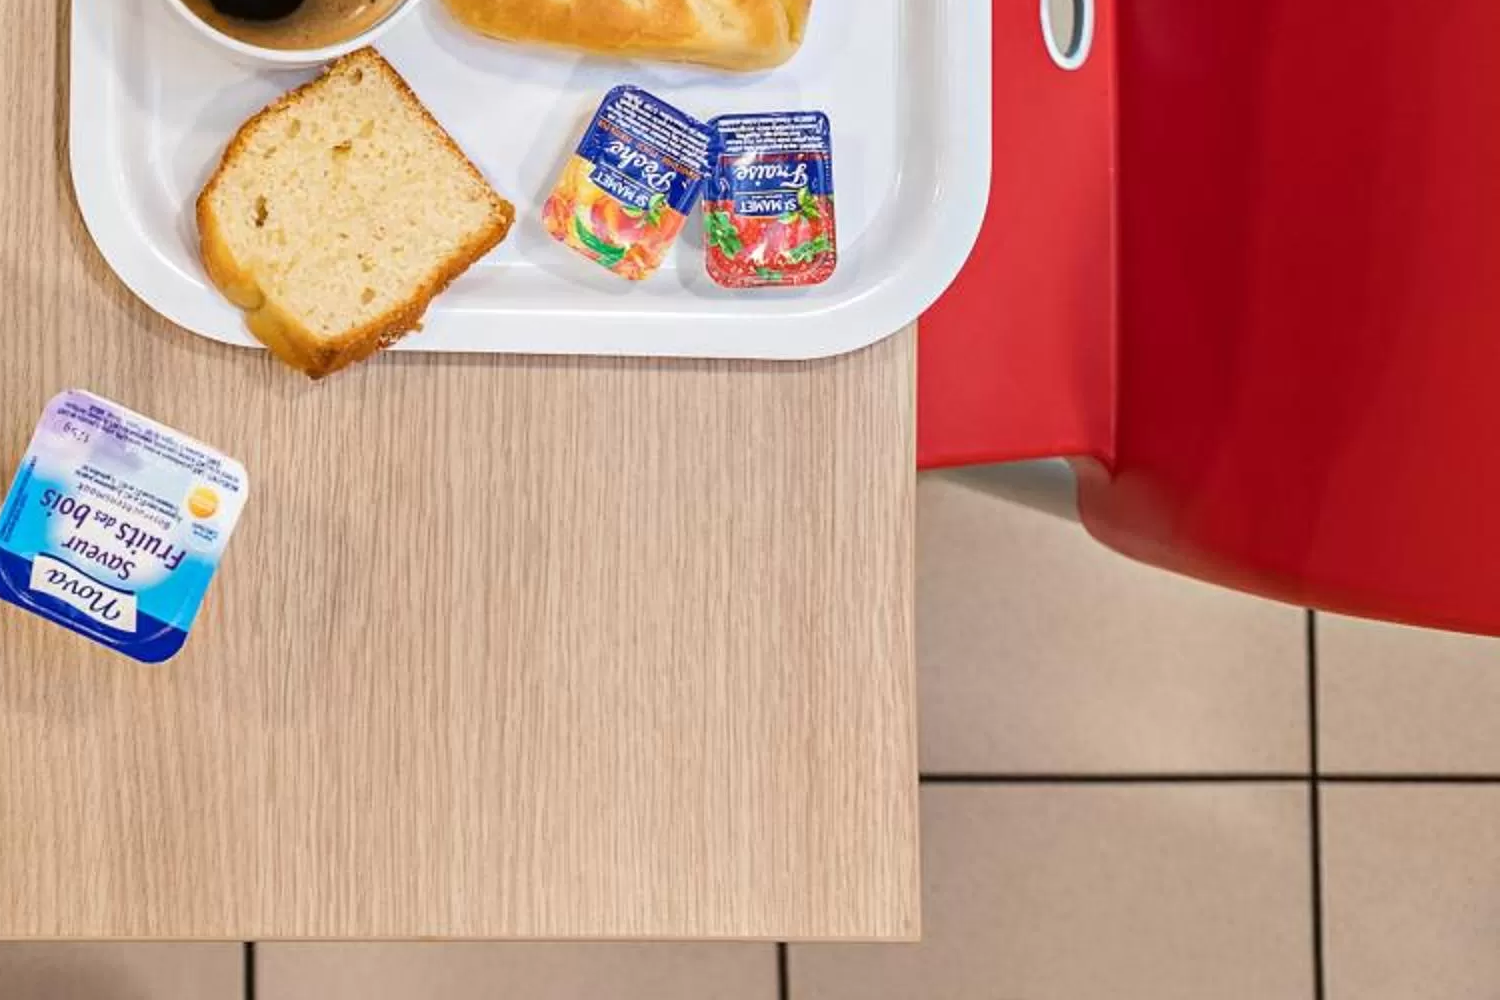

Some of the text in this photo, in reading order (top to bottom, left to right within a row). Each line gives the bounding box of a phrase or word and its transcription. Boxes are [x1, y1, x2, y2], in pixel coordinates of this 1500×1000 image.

[610, 139, 677, 193] Pêche
[735, 163, 809, 189] Fraise
[590, 171, 636, 204] MAMET
[739, 200, 783, 213] MAMET
[40, 488, 90, 529] bois
[93, 510, 117, 528] des
[60, 535, 138, 582] Saveur
[115, 521, 187, 571] Fruits
